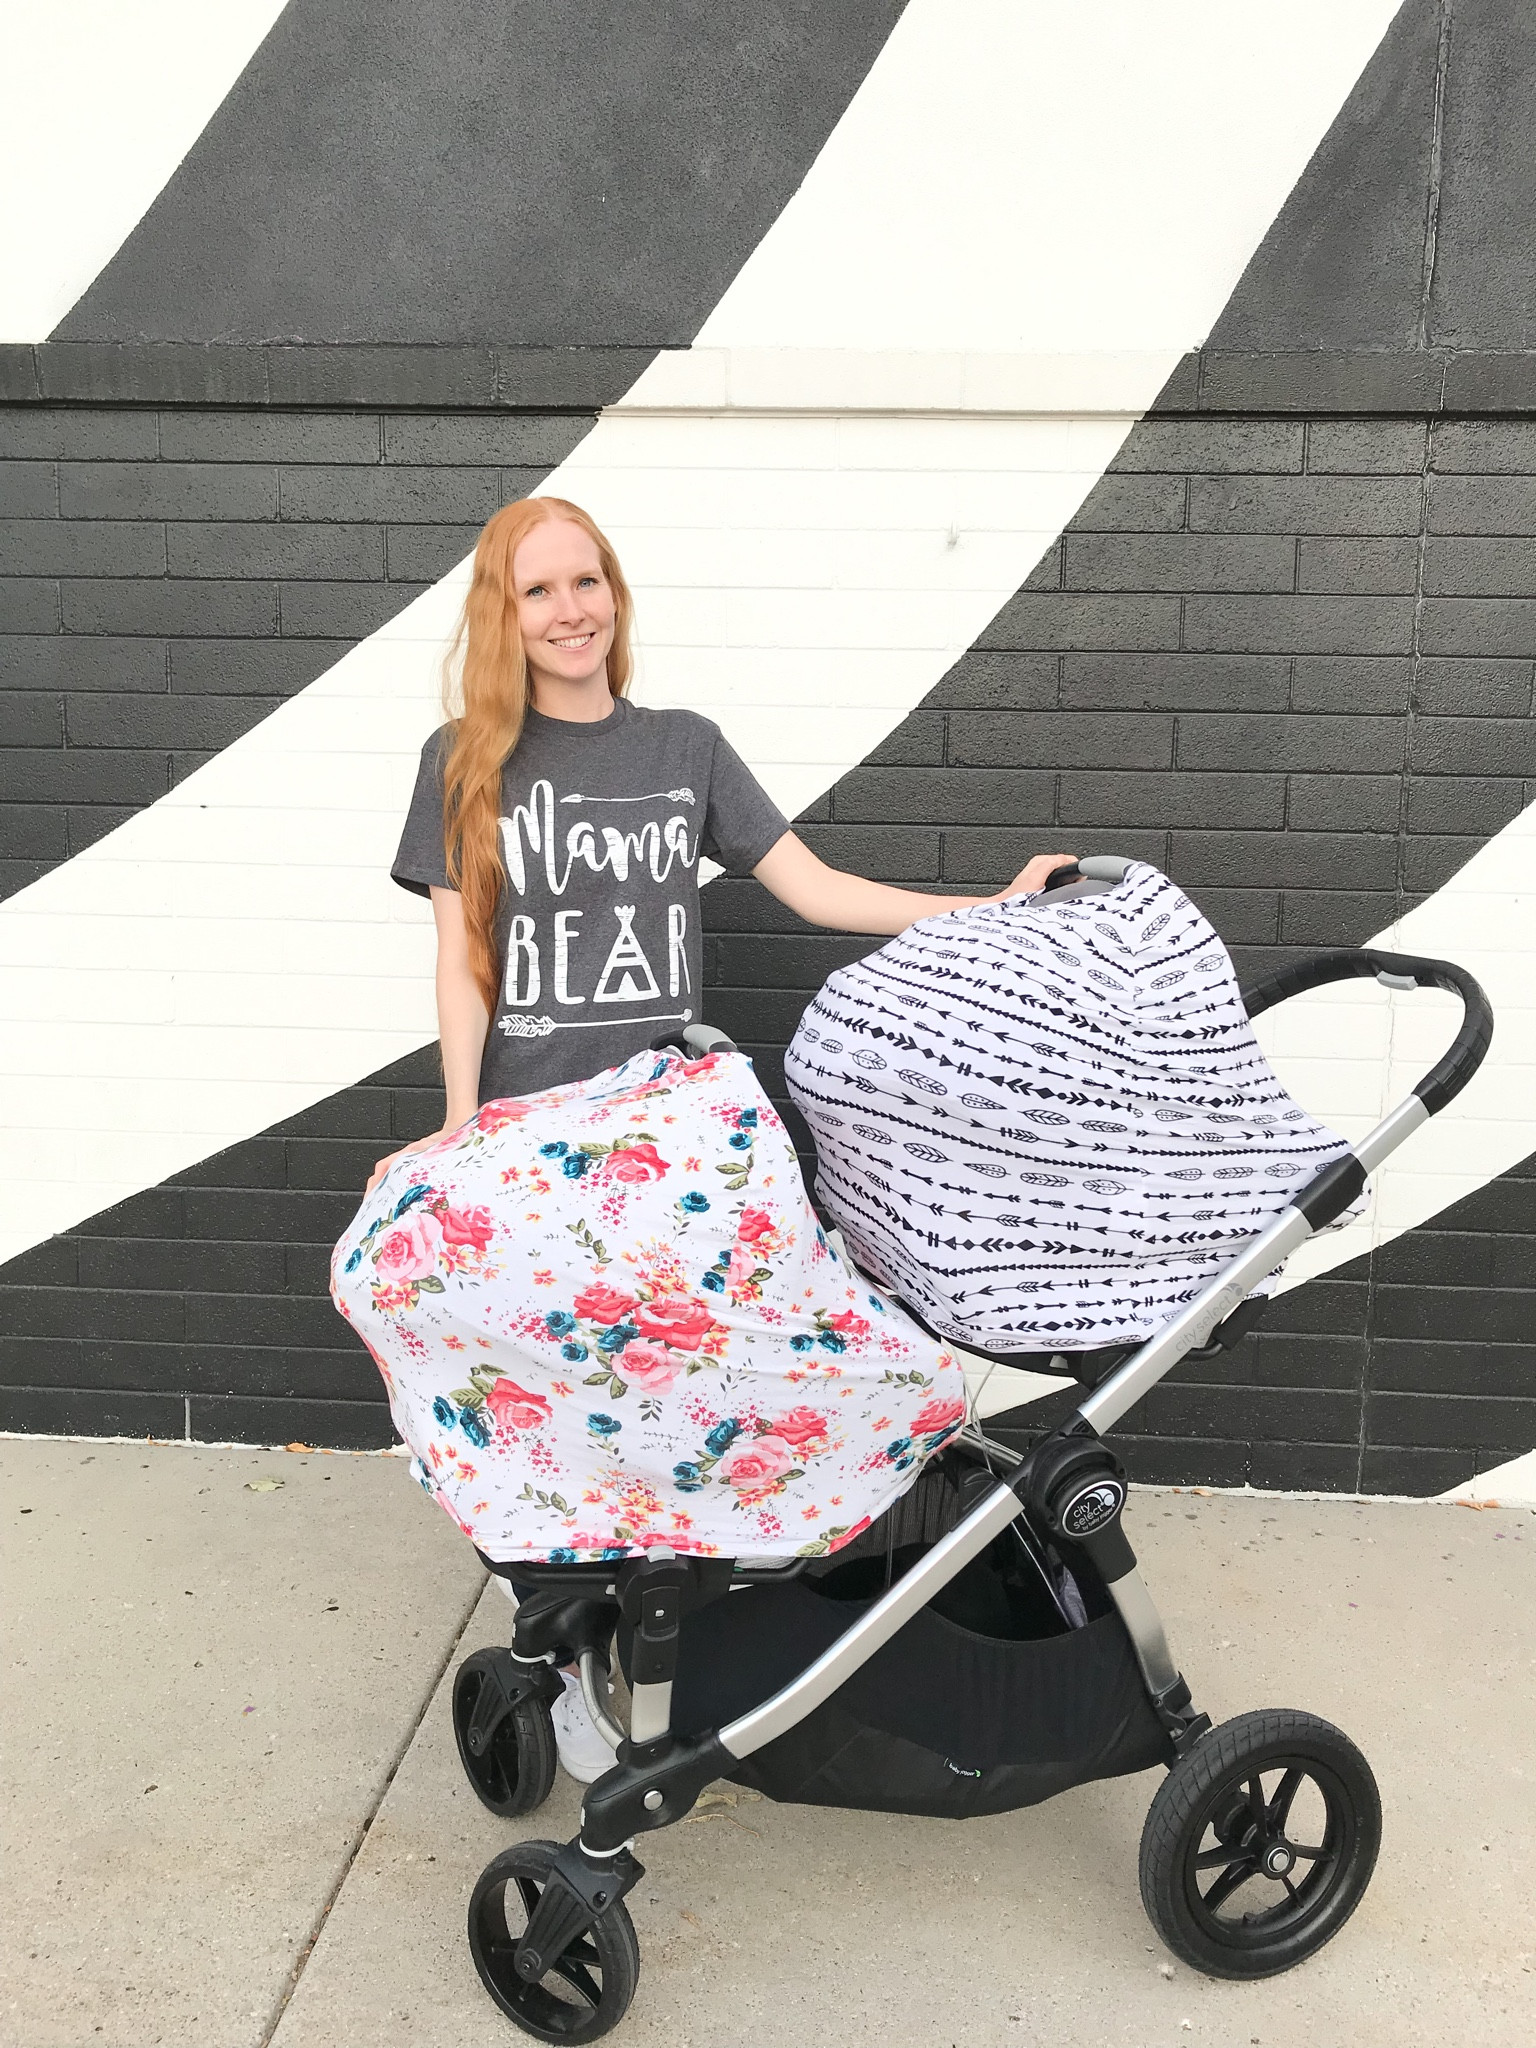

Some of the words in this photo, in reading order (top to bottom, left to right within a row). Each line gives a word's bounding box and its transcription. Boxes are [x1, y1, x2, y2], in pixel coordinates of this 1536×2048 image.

[497, 779, 698, 896] Mama
[505, 904, 691, 1006] BEAR
[1175, 1328, 1197, 1352] city
[1196, 1296, 1233, 1330] select
[1073, 1501, 1090, 1518] city
[1073, 1504, 1104, 1530] select
